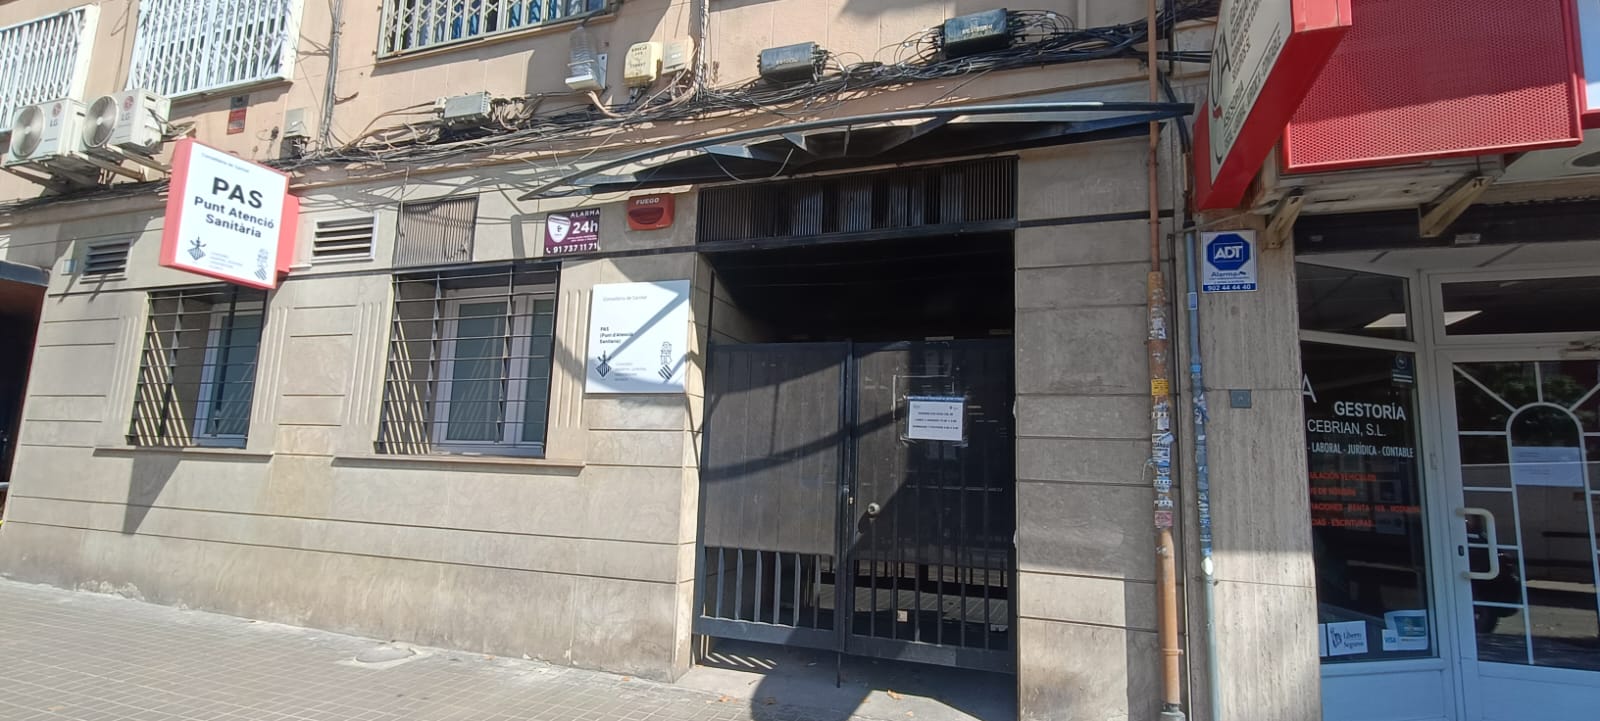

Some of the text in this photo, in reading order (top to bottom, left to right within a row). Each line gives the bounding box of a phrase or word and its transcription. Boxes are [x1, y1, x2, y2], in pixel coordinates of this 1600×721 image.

[212, 177, 263, 208] PAS
[635, 197, 660, 205] FUEGO
[194, 196, 274, 229] Punt Atenció
[570, 209, 600, 218] ALARMA
[206, 213, 262, 238] Sanitària
[572, 220, 598, 234] 24h
[563, 244, 578, 252] 737
[580, 243, 587, 251] 11
[588, 242, 597, 250] 71
[1213, 246, 1244, 260] ADT
[1334, 400, 1406, 420] GESTORÍA
[1307, 419, 1387, 436] CEBRIAN, S.L.
[1311, 442, 1414, 458] LABORAL JURÍDICA CONTABLE
